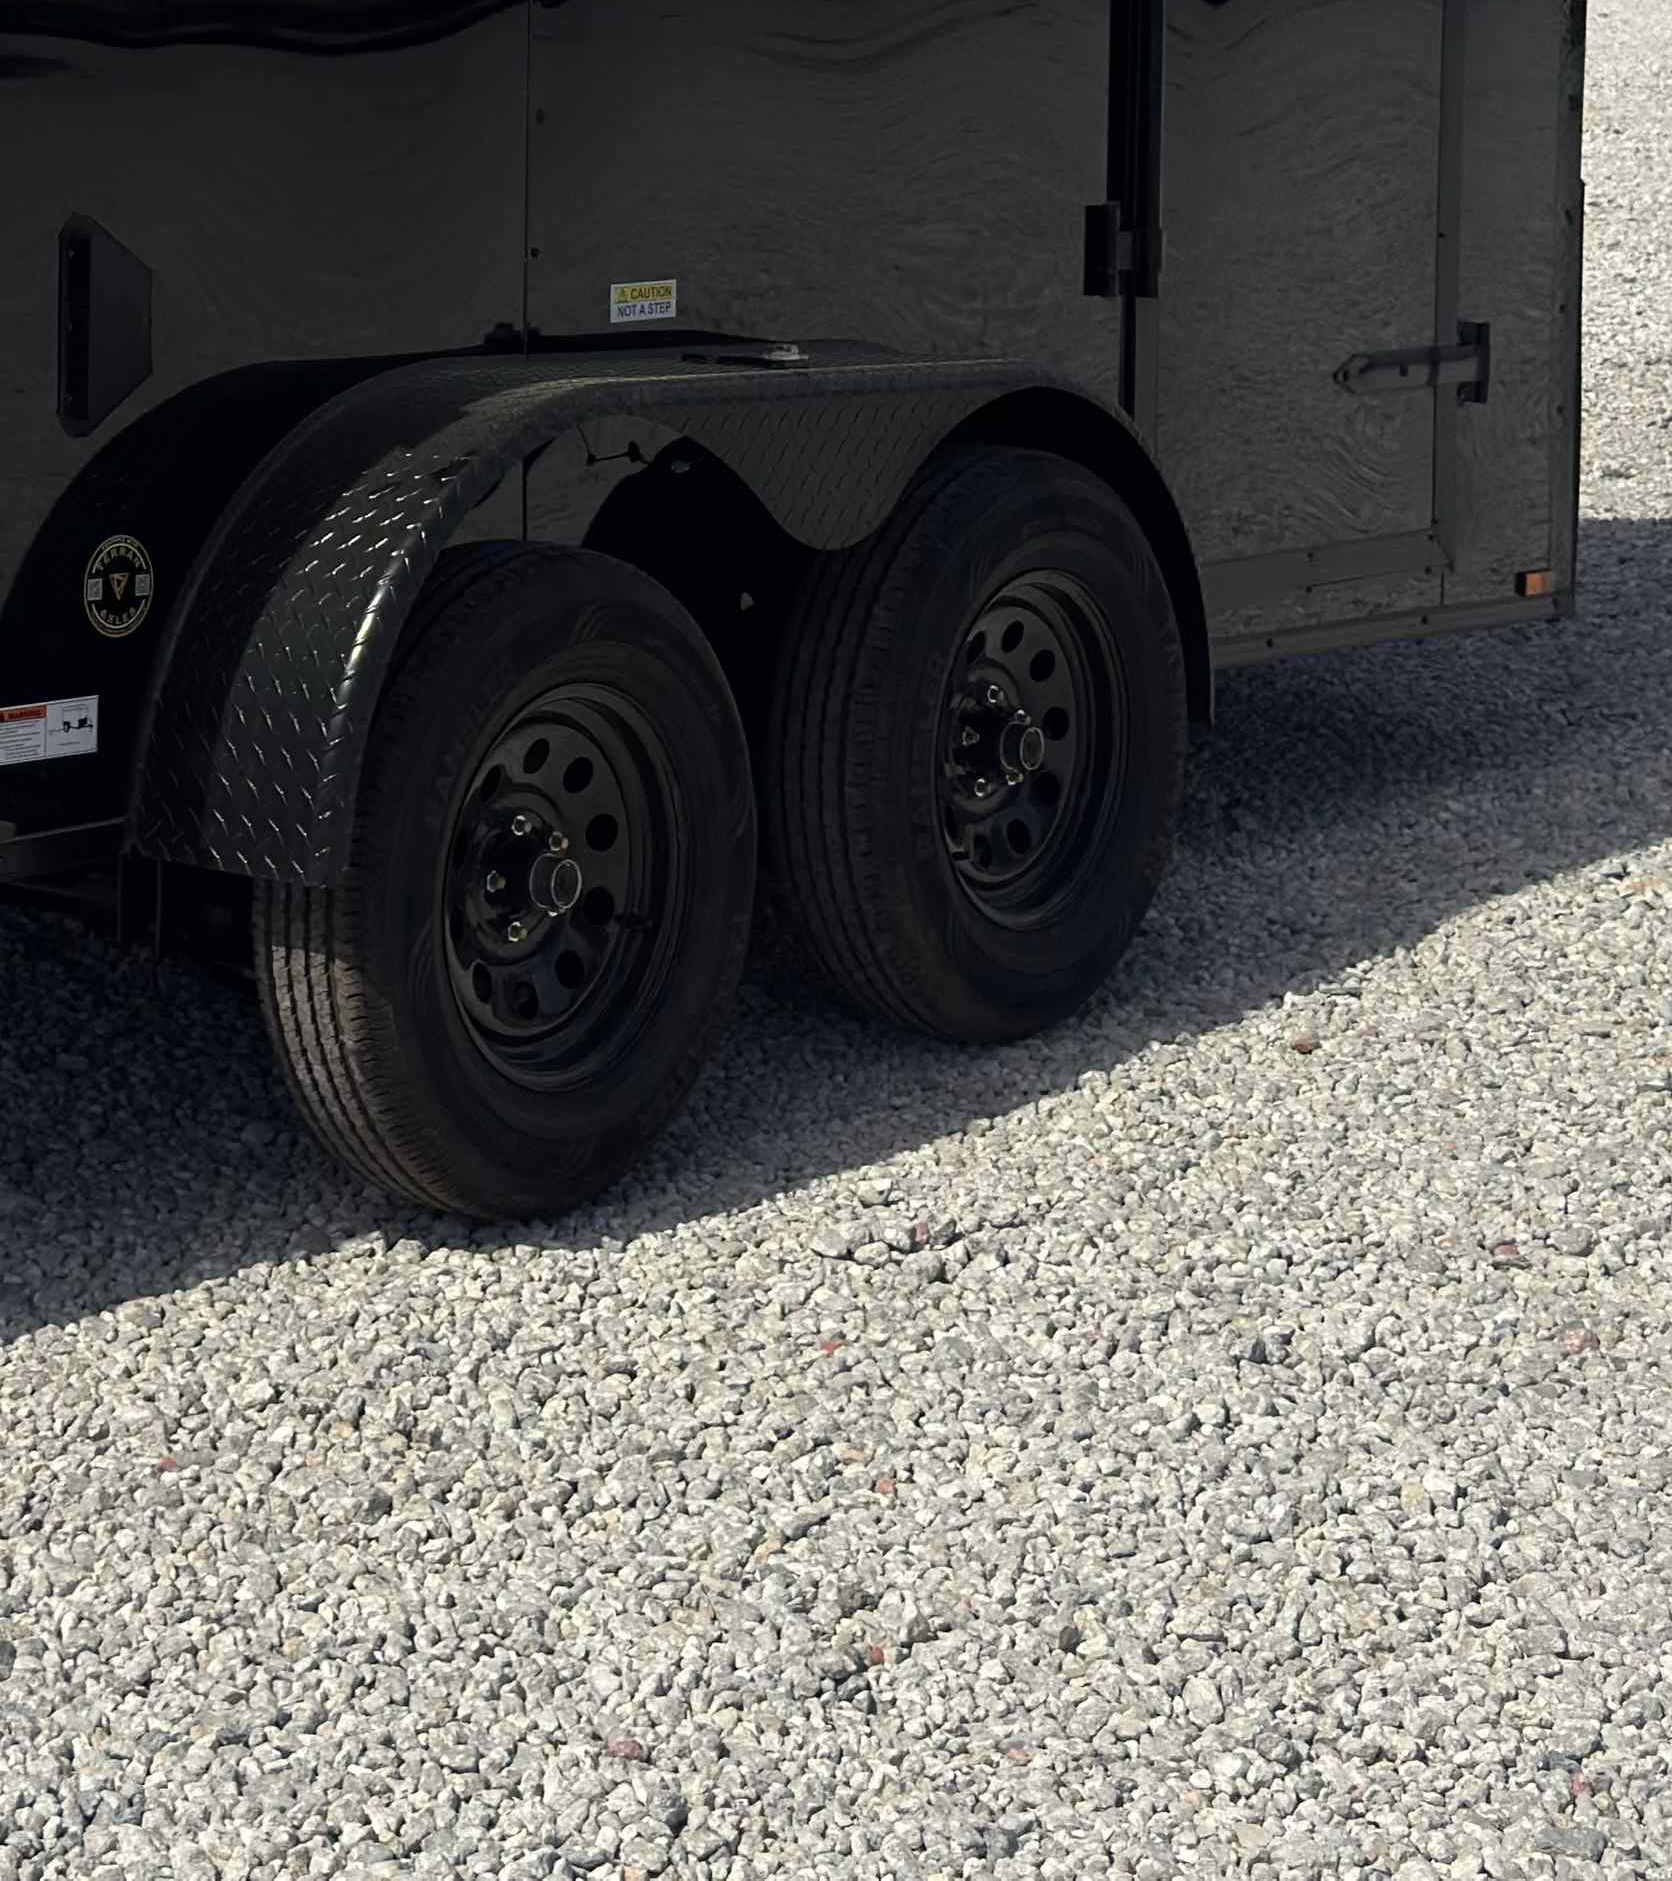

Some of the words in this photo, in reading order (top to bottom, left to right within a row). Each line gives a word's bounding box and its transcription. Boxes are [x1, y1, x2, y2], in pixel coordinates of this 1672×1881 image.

[630, 285, 672, 299] CAUTION
[617, 304, 637, 318] NOT
[639, 304, 646, 315] A
[648, 301, 671, 314] STEP
